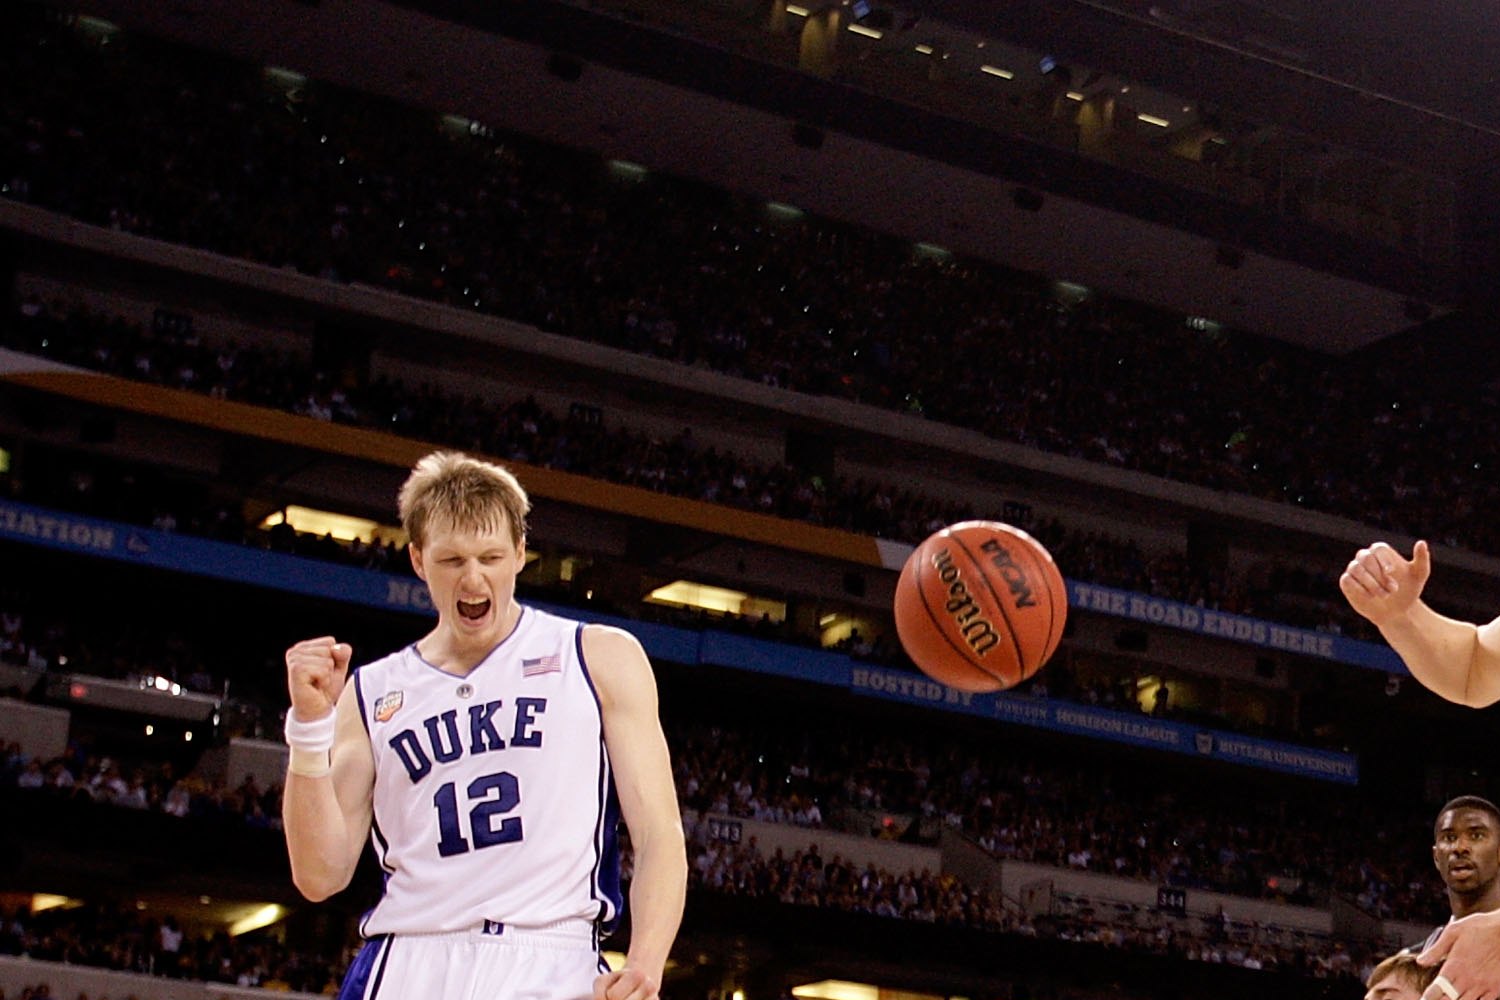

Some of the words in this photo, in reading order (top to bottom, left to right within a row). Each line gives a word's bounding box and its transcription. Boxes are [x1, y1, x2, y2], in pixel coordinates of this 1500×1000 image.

[0, 507, 115, 550] IATION
[931, 546, 1002, 658] Wilson
[981, 538, 1037, 611] NCAA
[1075, 583, 1126, 617] THE
[1129, 596, 1200, 631] ROAD
[1202, 612, 1267, 645] ENDS
[1269, 625, 1335, 659] HERE
[852, 668, 944, 702] HOSTED
[1055, 707, 1122, 733] HORIZON
[388, 697, 548, 785] DUKE
[1218, 739, 1274, 762] BUTLER
[1274, 749, 1355, 777] UNIVERSITY
[433, 771, 523, 858] 12
